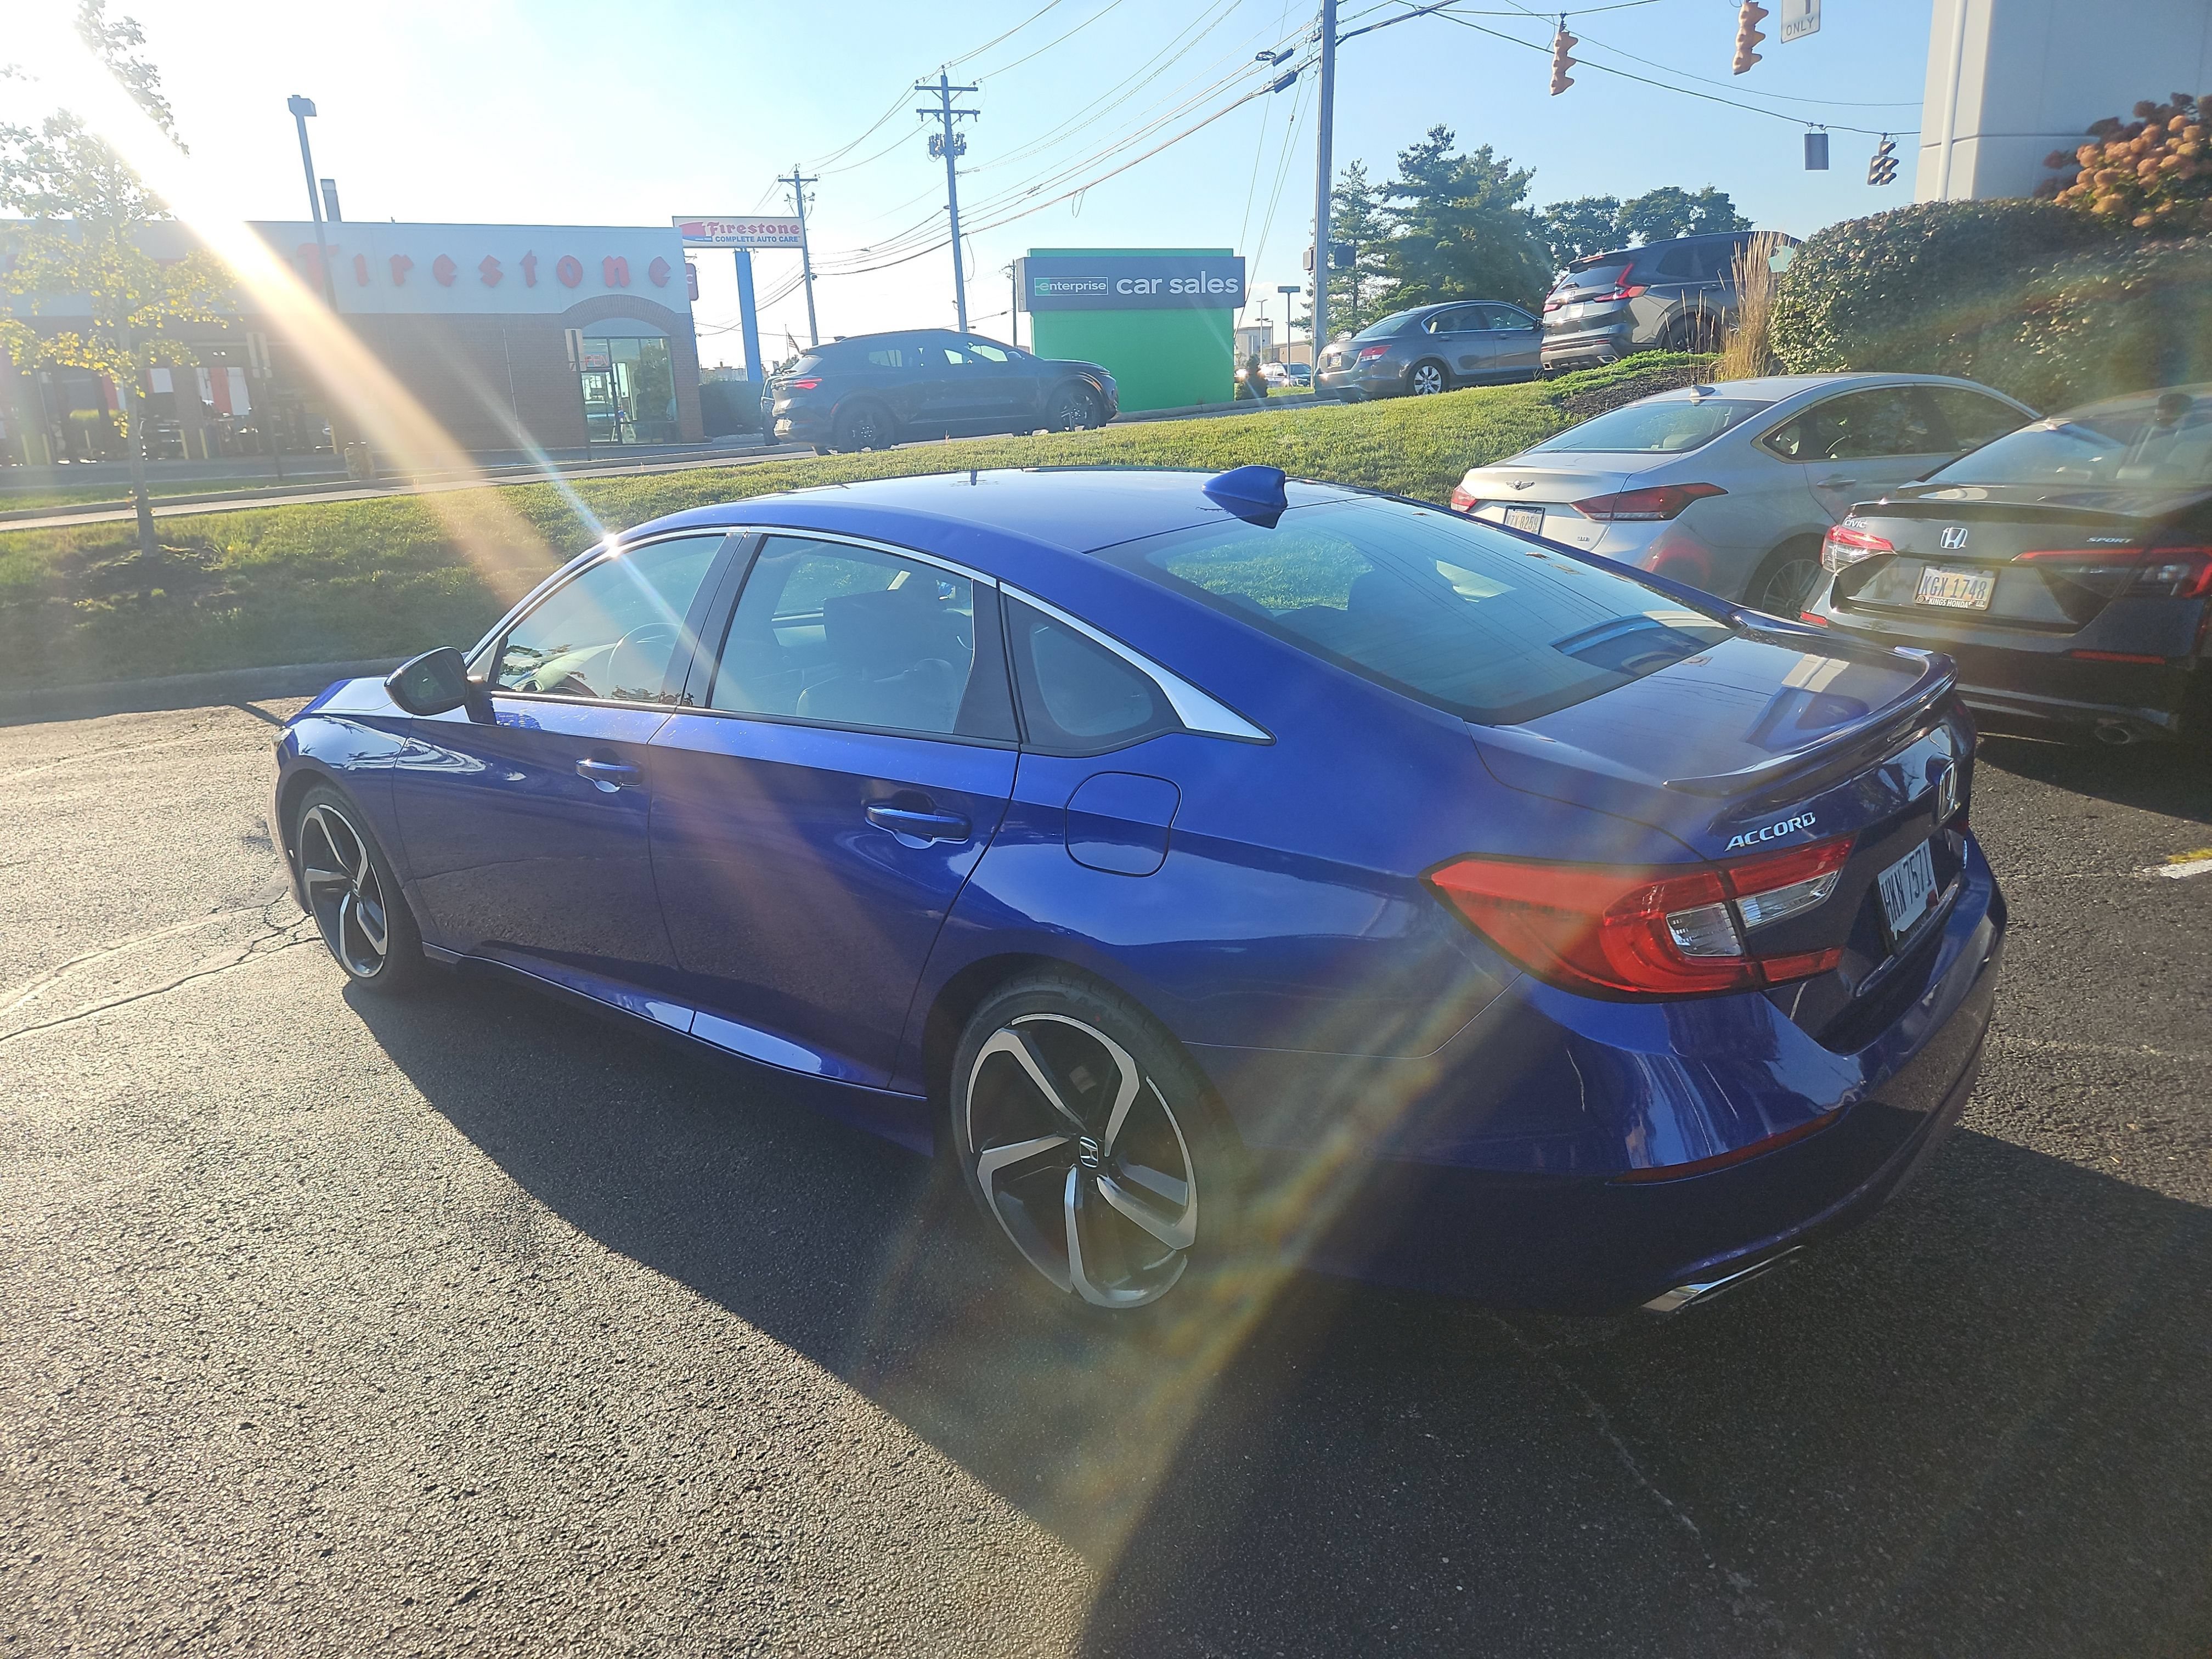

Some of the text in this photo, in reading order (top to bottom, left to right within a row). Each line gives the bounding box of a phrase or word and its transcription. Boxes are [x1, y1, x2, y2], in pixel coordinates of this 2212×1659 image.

[1786, 16, 1814, 36] ONLY
[707, 222, 800, 236] Firestone
[296, 242, 672, 292] Firestone
[1036, 270, 1239, 295] enterprise car sales
[584, 354, 610, 367] PEN
[1519, 516, 1539, 530] 8259
[1921, 575, 1987, 600] KGX 1748
[1928, 597, 1947, 606] KINGS
[1947, 600, 1968, 608] HONDA
[1724, 811, 1816, 851] ACCORD
[1881, 845, 1932, 924] HKN 7571
